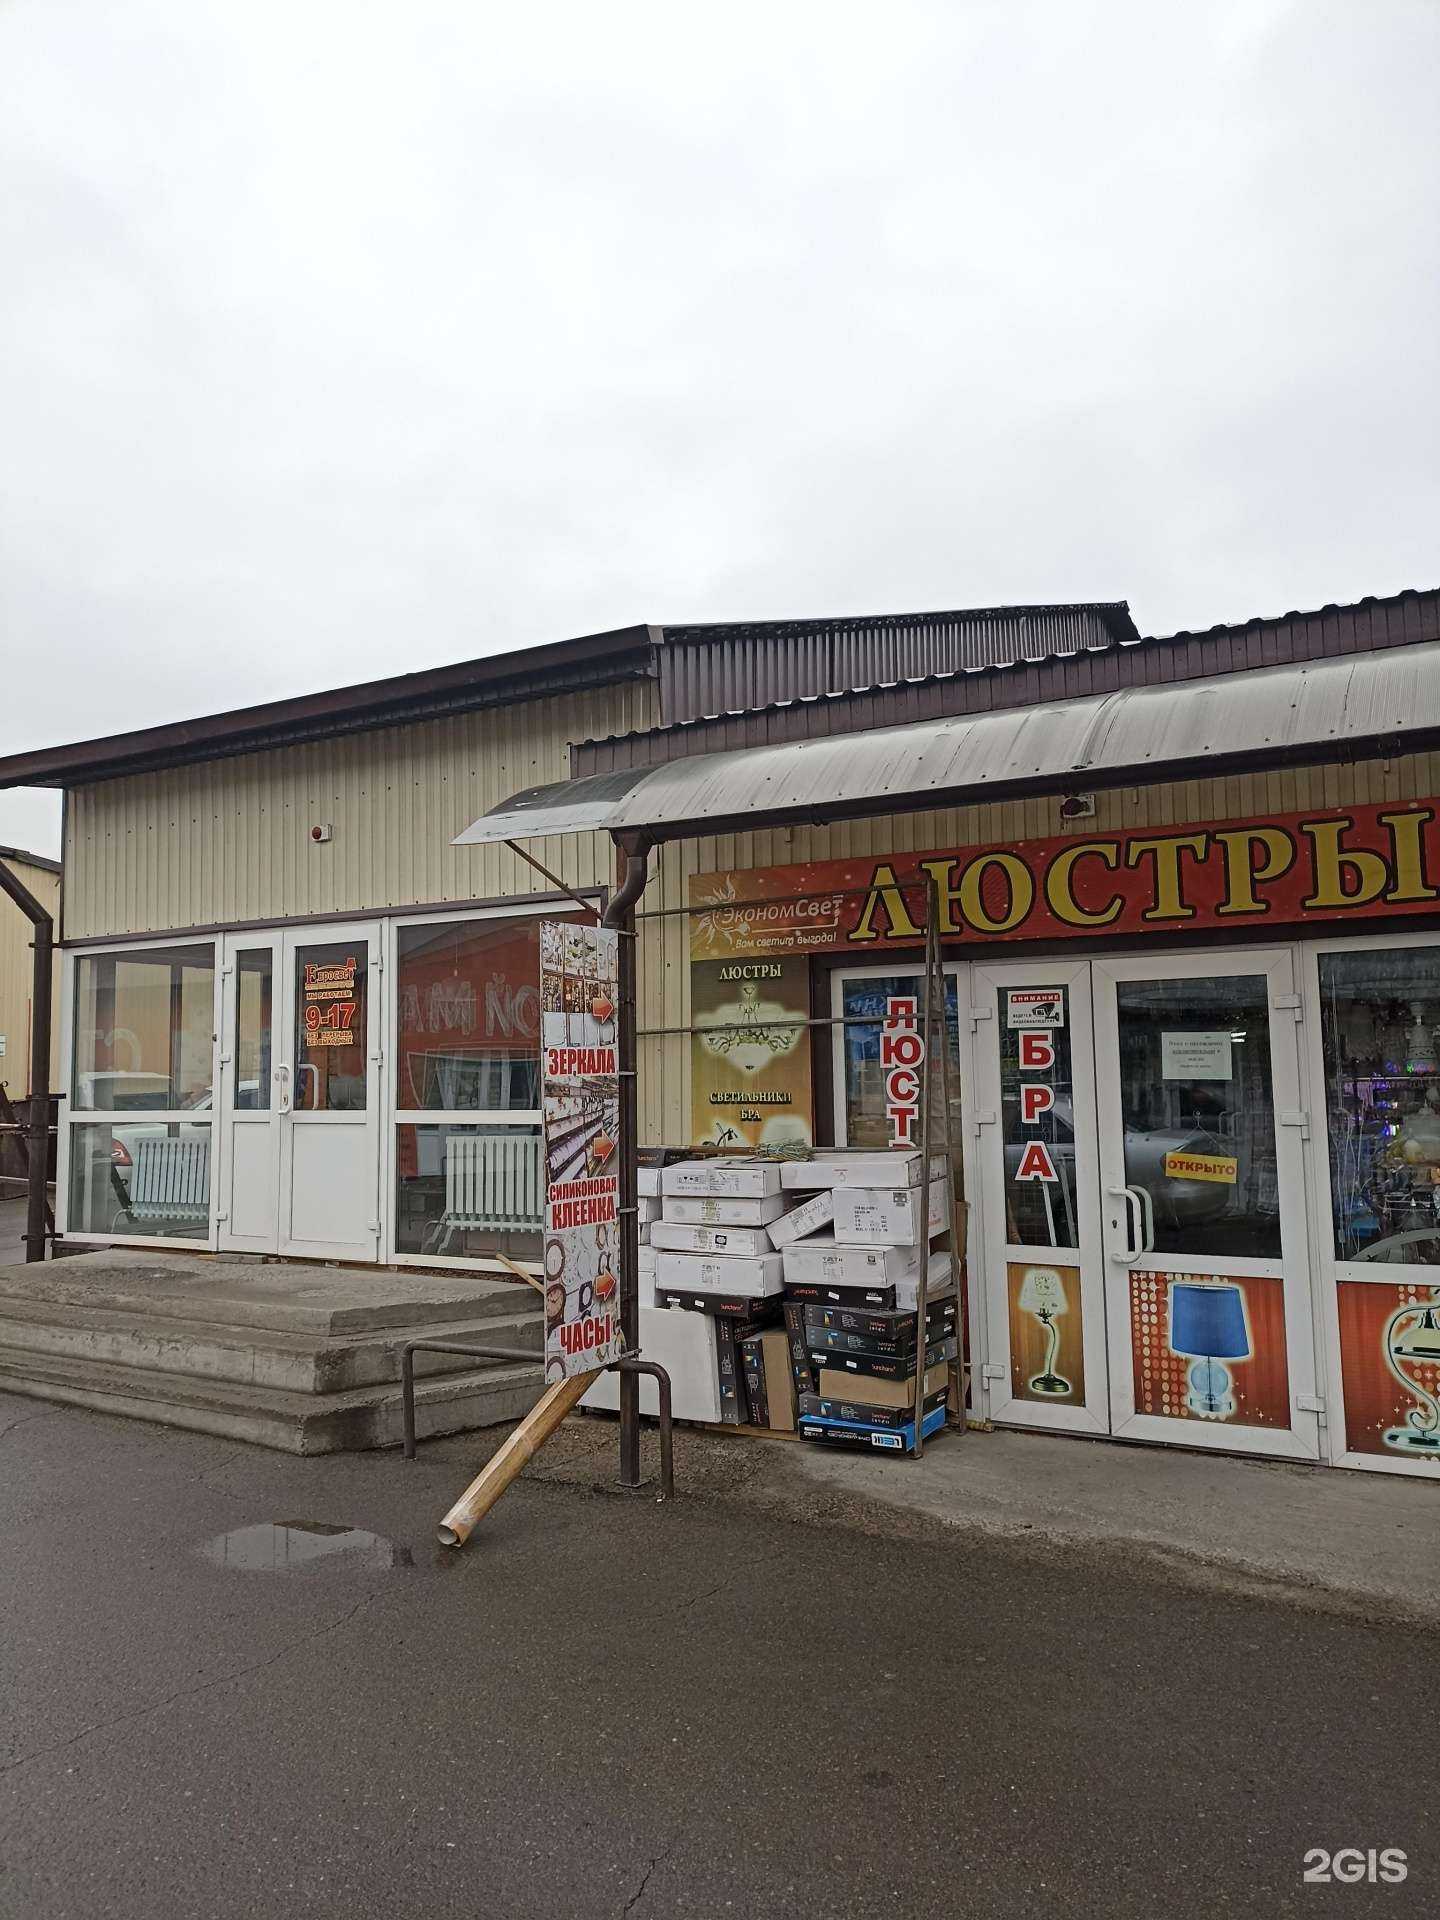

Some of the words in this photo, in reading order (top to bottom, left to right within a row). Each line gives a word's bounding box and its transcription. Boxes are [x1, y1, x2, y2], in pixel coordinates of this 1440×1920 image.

[848, 810, 1440, 940] ЛЮСТРЫ
[736, 938, 754, 948] Вам
[756, 936, 795, 947] светит
[797, 931, 836, 945] выгода!
[719, 964, 782, 980] ЛЮСТРЫ
[1012, 994, 1059, 1002] ВНИМАНИЕ
[306, 1003, 356, 1031] 9-17
[548, 1048, 616, 1076] ЗЕРКАЛА
[881, 998, 924, 1147] ЛЮСТ
[710, 1091, 792, 1103] СВЕТИЛЬНИКИ
[1017, 1033, 1057, 1179] БРА
[741, 1109, 761, 1120] БРА
[1168, 1160, 1235, 1175] ОТКРЫТО
[549, 1177, 617, 1202] СИЛИКОНОВАЯ
[552, 1196, 616, 1230] КЛЕЕНКА
[560, 1315, 611, 1355] ЧАСЫ
